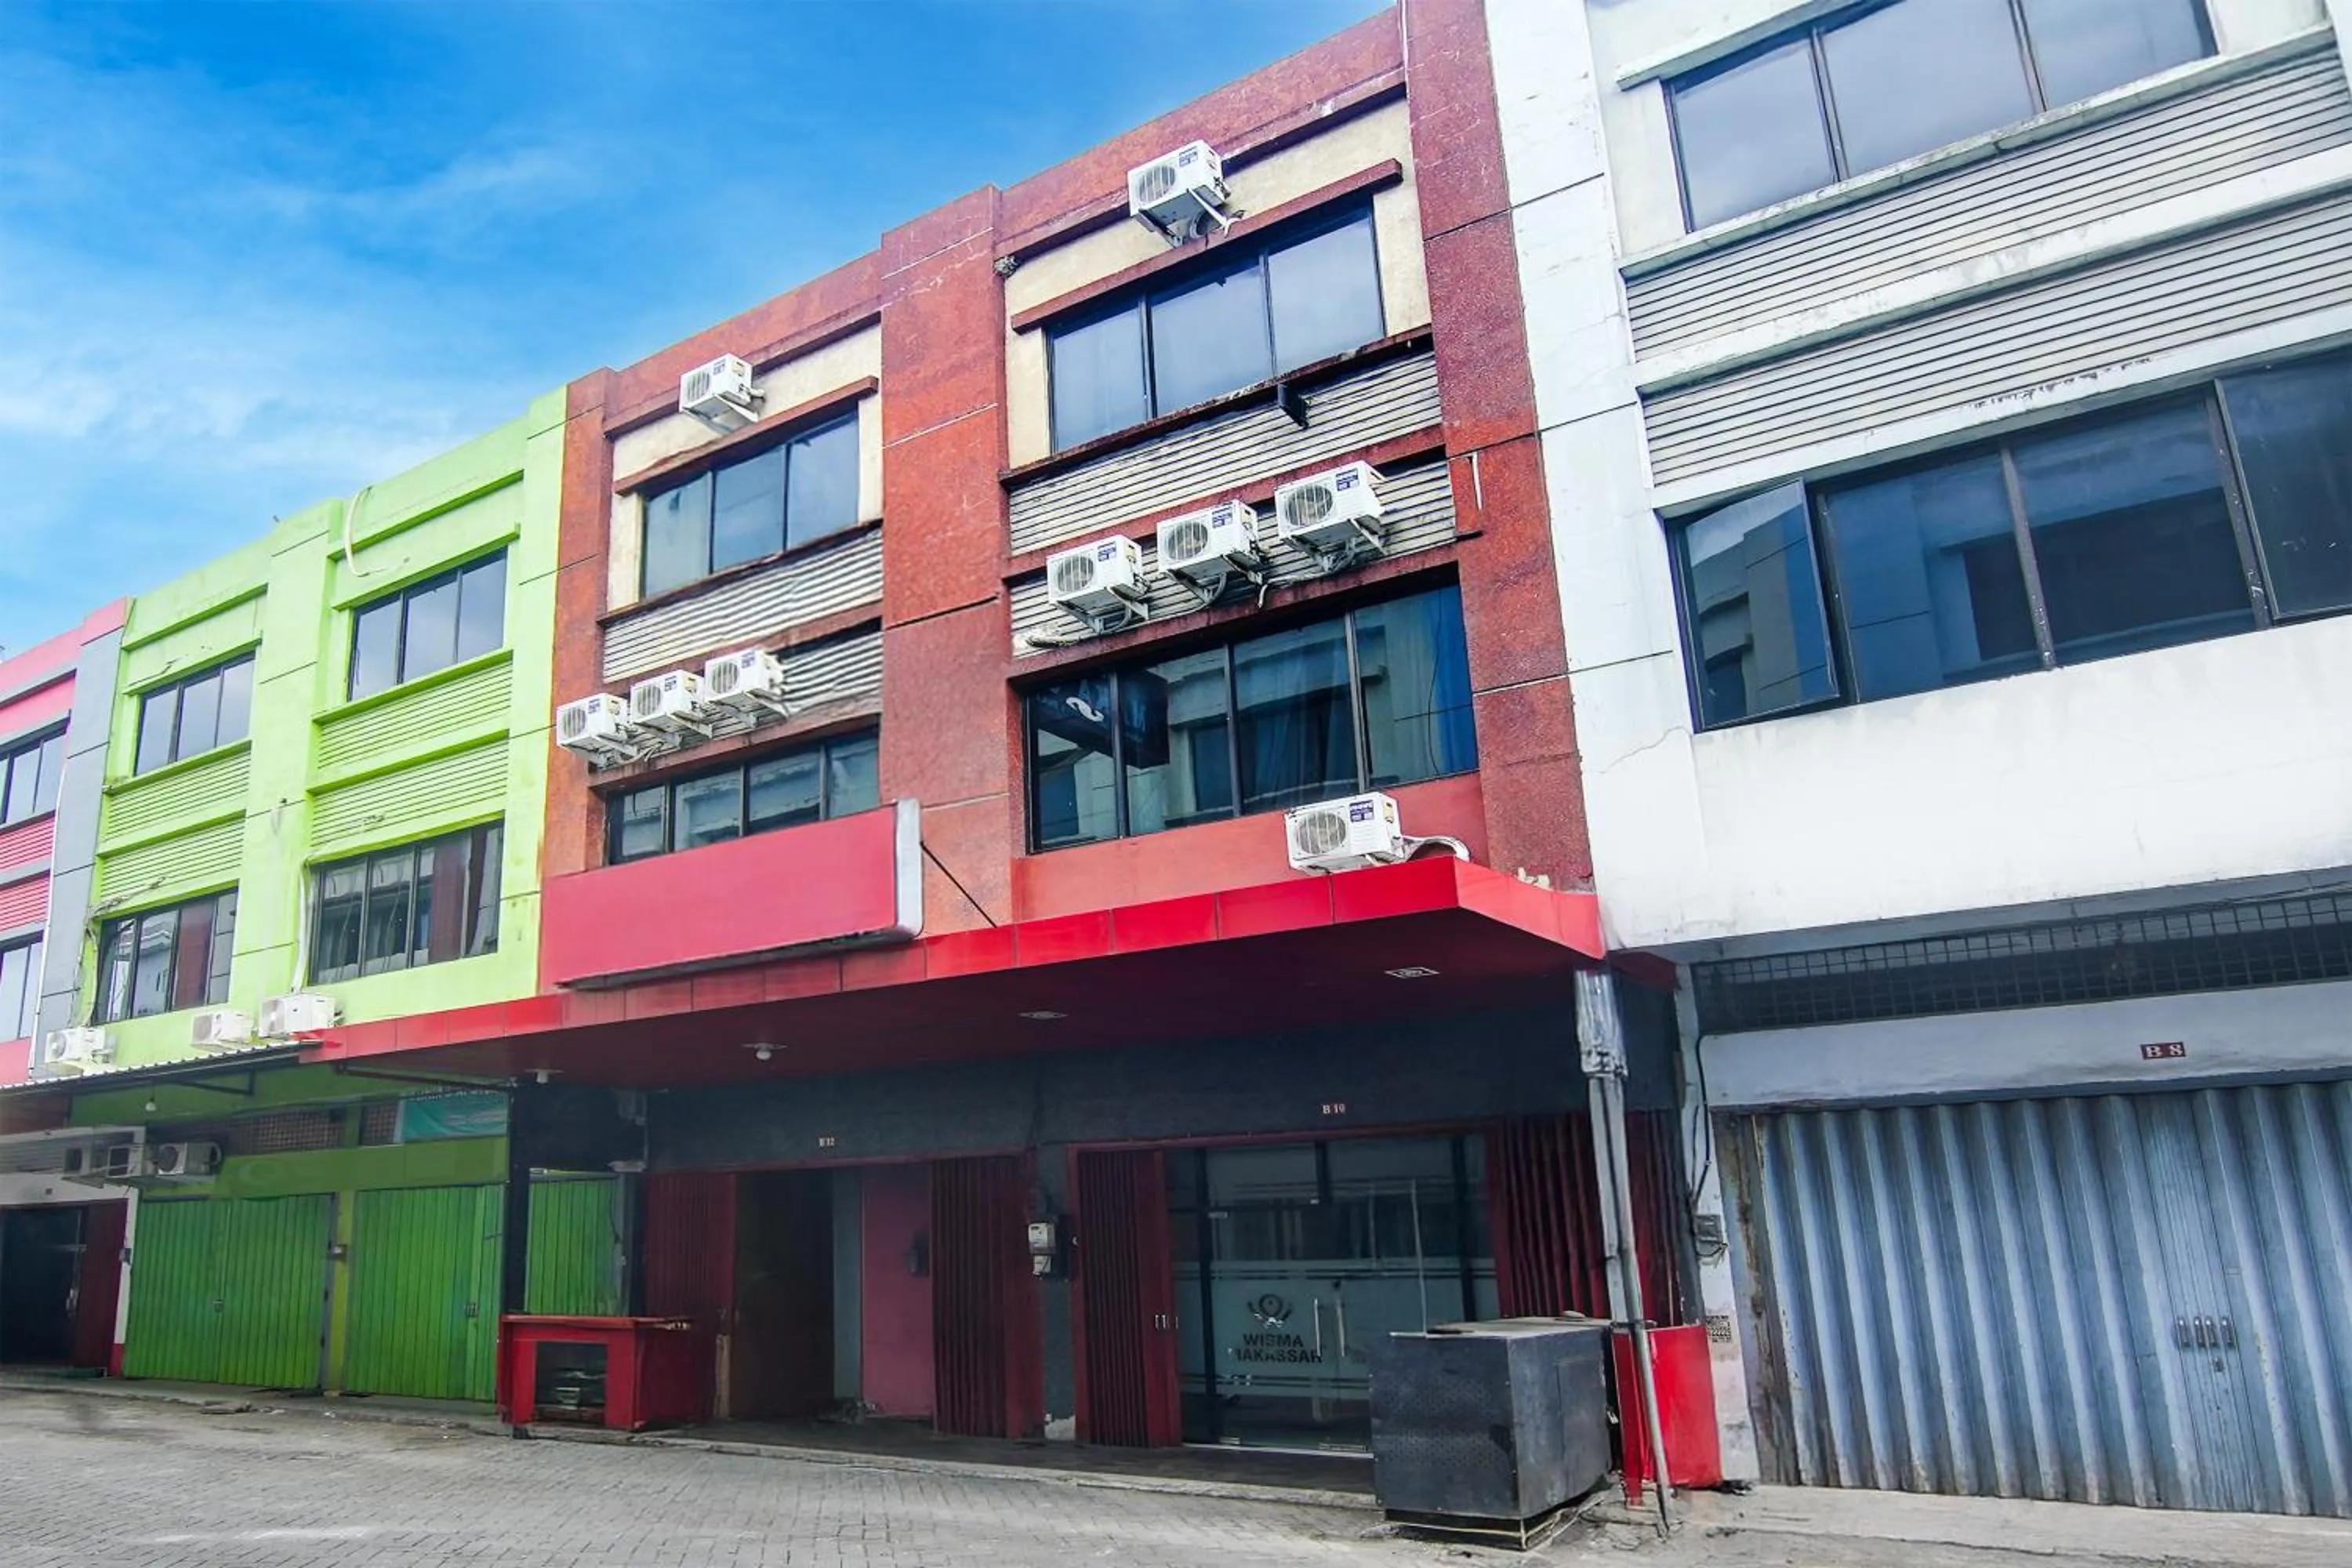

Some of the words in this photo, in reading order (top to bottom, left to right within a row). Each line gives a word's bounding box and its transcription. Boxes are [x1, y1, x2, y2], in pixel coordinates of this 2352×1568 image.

[2146, 1045, 2163, 1058] B
[2169, 1044, 2183, 1056] 8
[1322, 1105, 1330, 1114] B
[1243, 1333, 1304, 1348] WISMA
